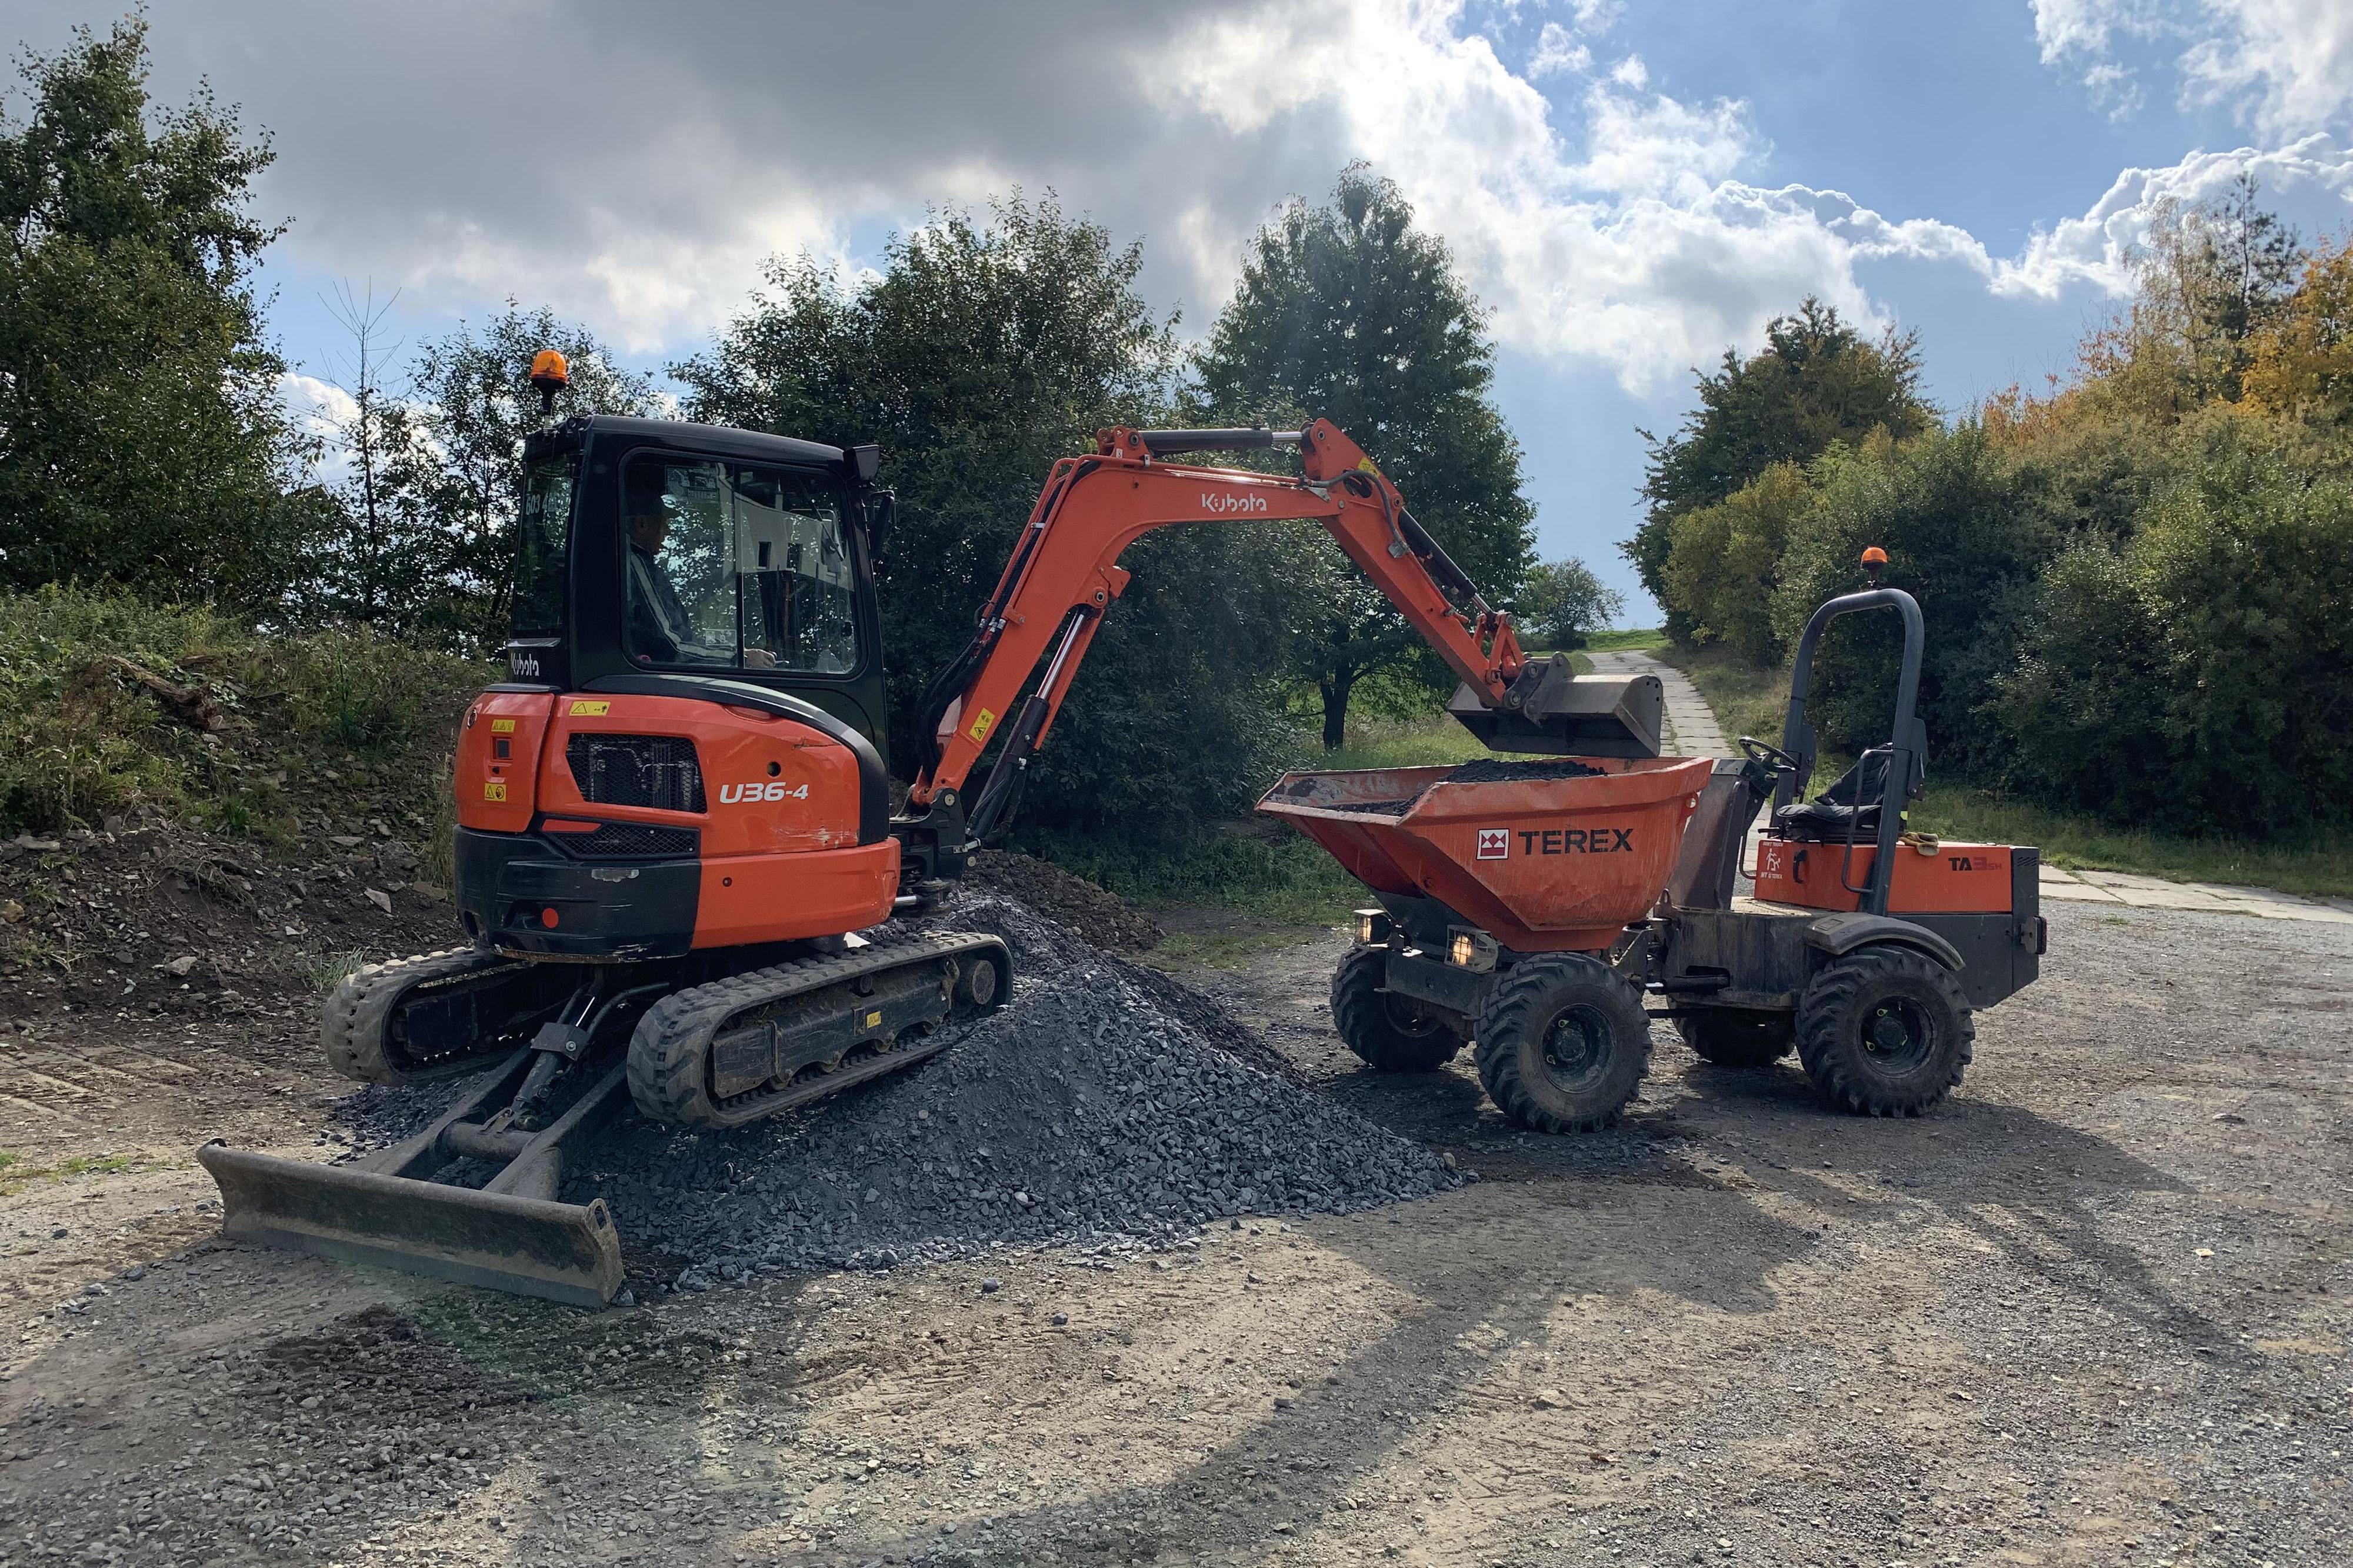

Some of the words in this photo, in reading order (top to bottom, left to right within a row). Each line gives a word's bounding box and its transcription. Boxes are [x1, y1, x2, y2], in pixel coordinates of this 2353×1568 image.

[1201, 492, 1267, 512] Kubota
[511, 653, 539, 676] Kubota
[719, 782, 809, 804] U36-4
[1518, 828, 1634, 855] TEREX
